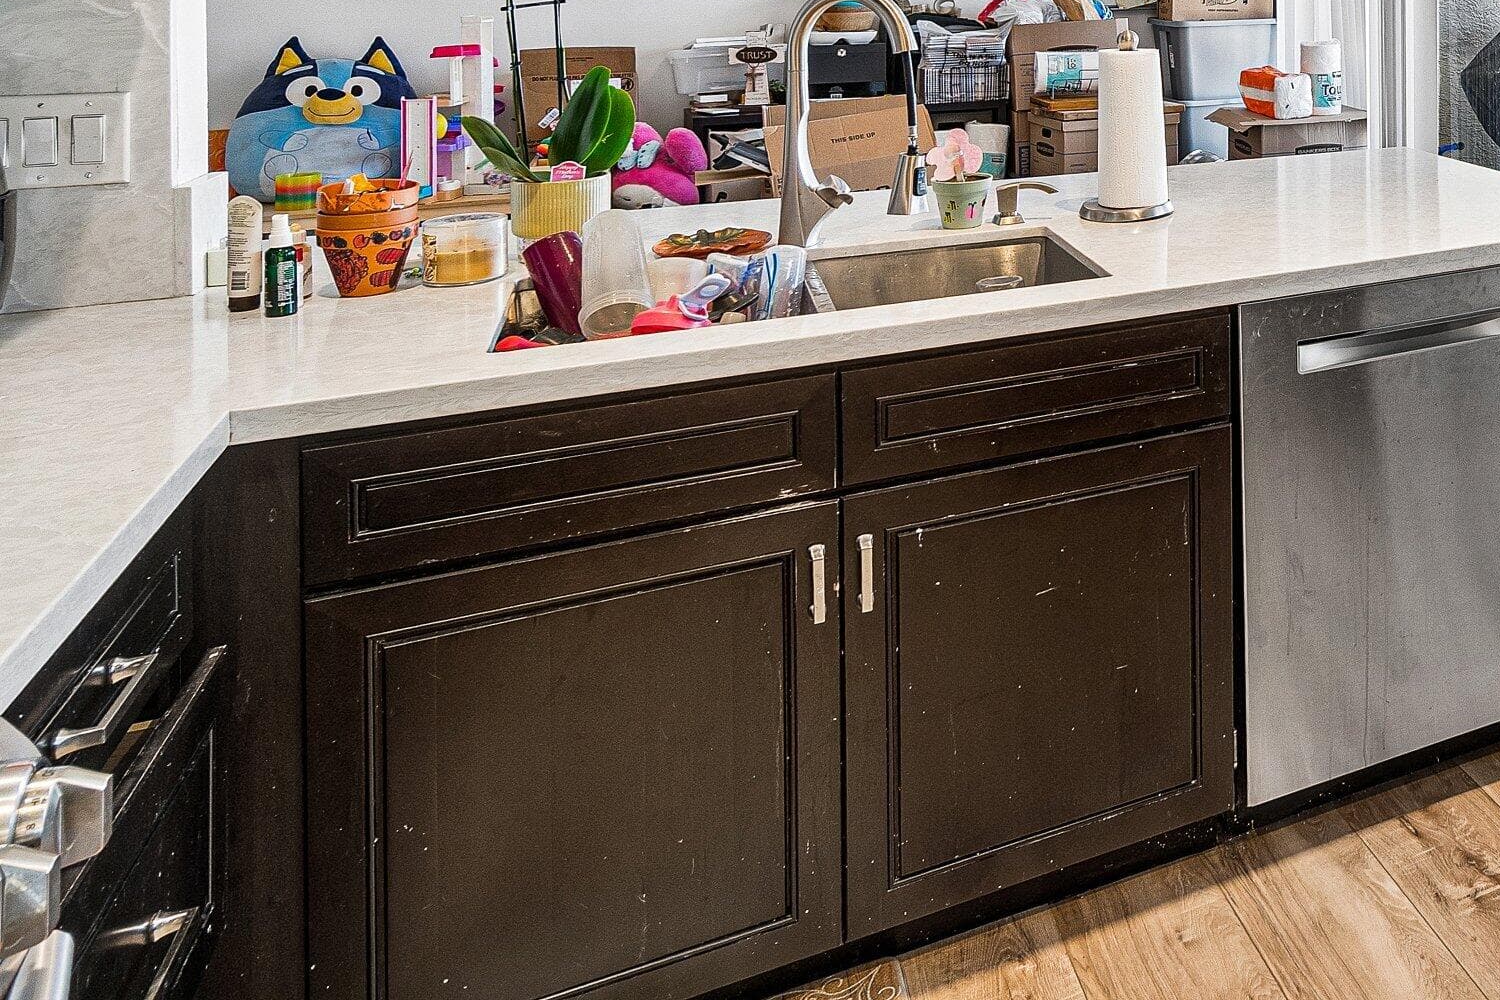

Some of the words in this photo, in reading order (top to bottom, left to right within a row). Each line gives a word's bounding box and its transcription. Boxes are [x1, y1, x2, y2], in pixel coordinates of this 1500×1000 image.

[740, 50, 773, 60] TRUST
[848, 133, 865, 141] SIDE
[866, 131, 876, 139] UP
